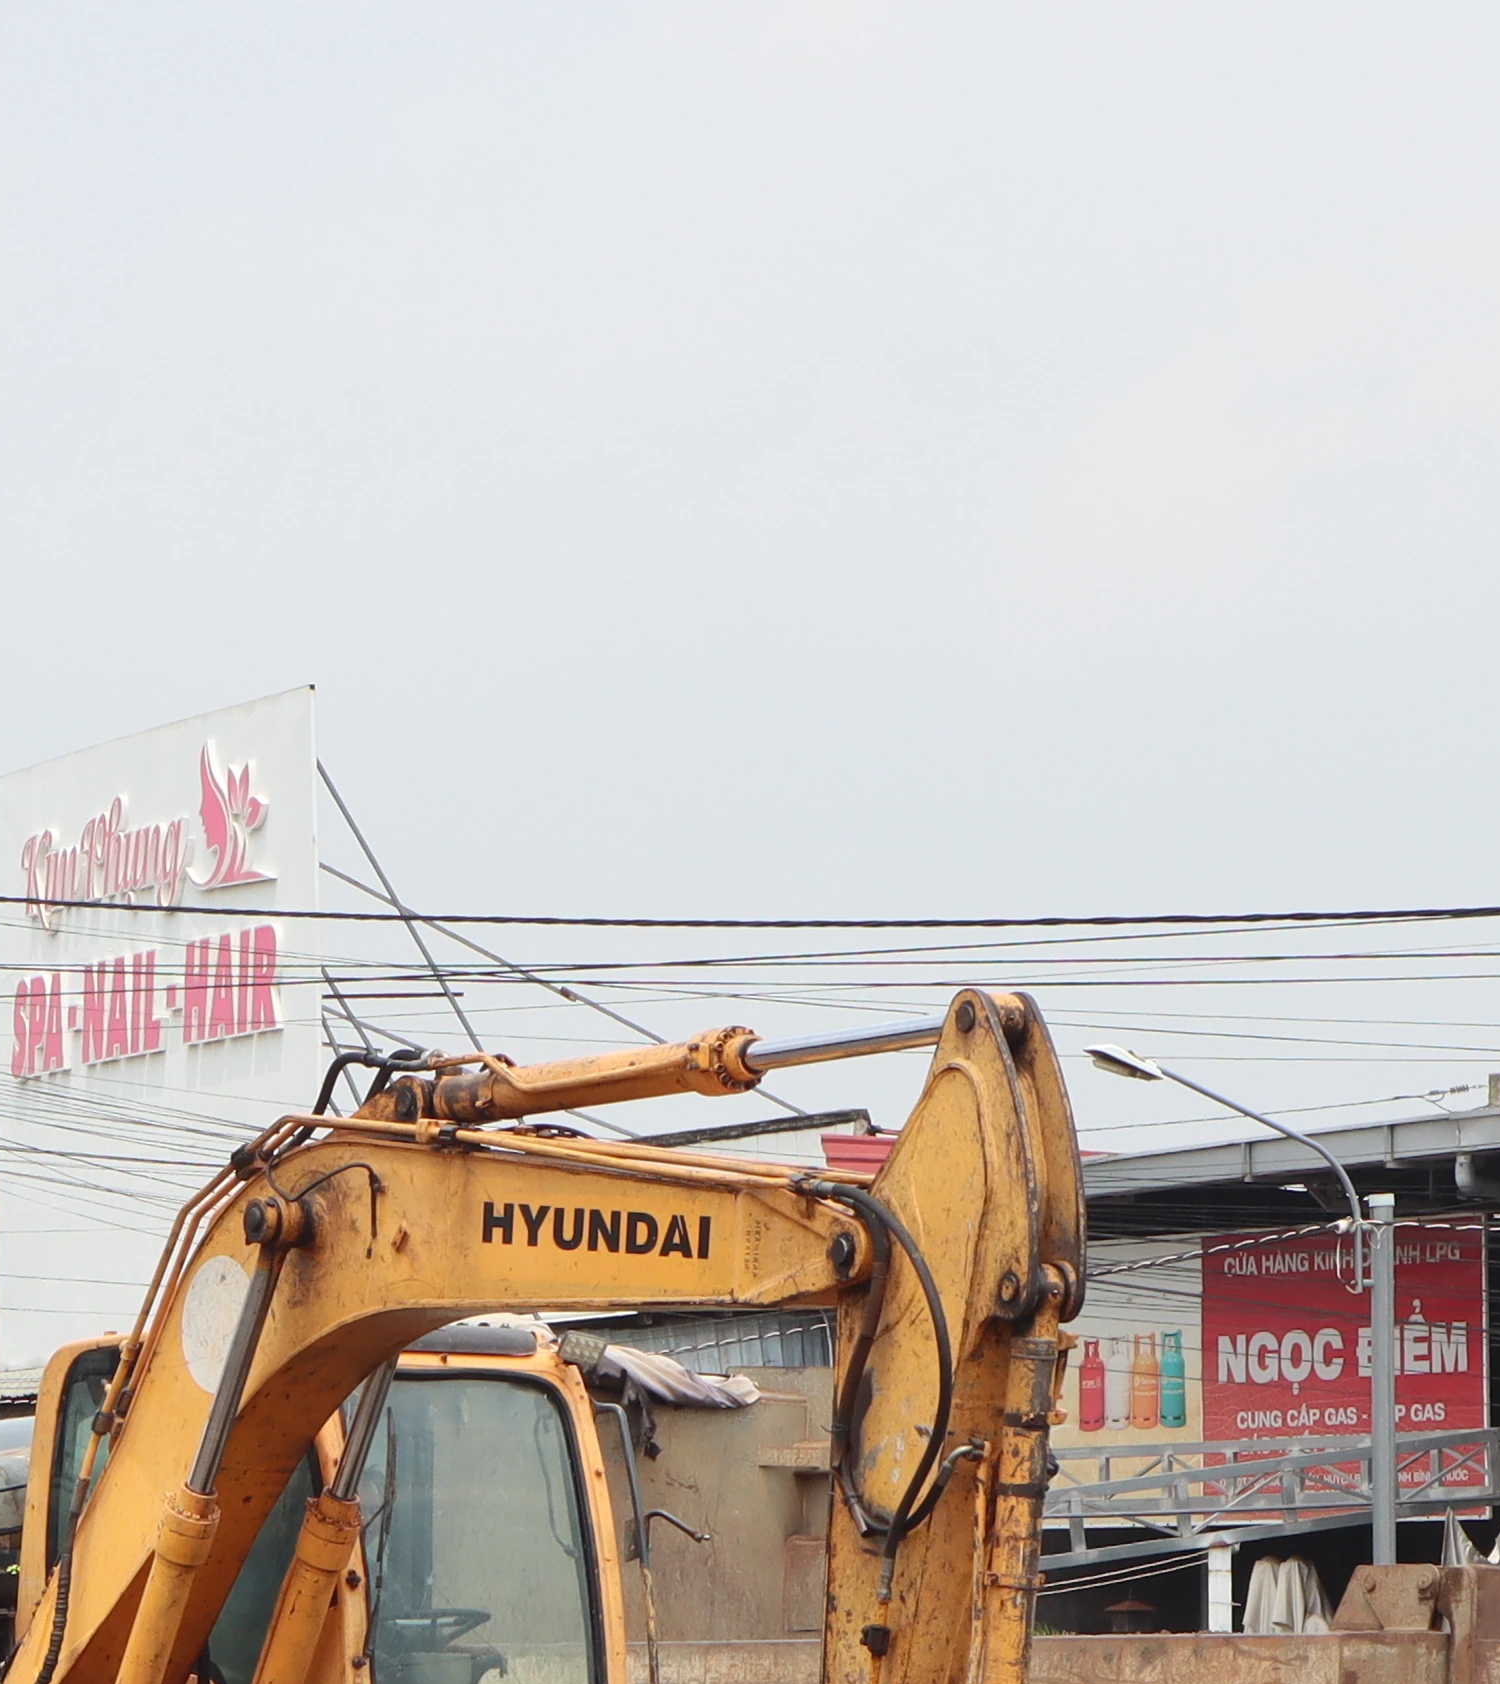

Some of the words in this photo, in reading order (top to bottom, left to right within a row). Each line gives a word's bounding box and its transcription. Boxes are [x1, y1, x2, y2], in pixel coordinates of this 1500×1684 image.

[481, 1201, 711, 1260] HYUNDAI
[1224, 1251, 1258, 1277] CỬA
[1261, 1249, 1309, 1275] HÀNG
[1313, 1249, 1354, 1270] KINH
[1425, 1242, 1460, 1263] LPG
[1217, 1328, 1344, 1395] NGỌC
[1237, 1410, 1282, 1430] CUNG
[1287, 1403, 1319, 1427] CẤP
[1324, 1407, 1357, 1425] GAS
[1410, 1402, 1445, 1423] GAS
